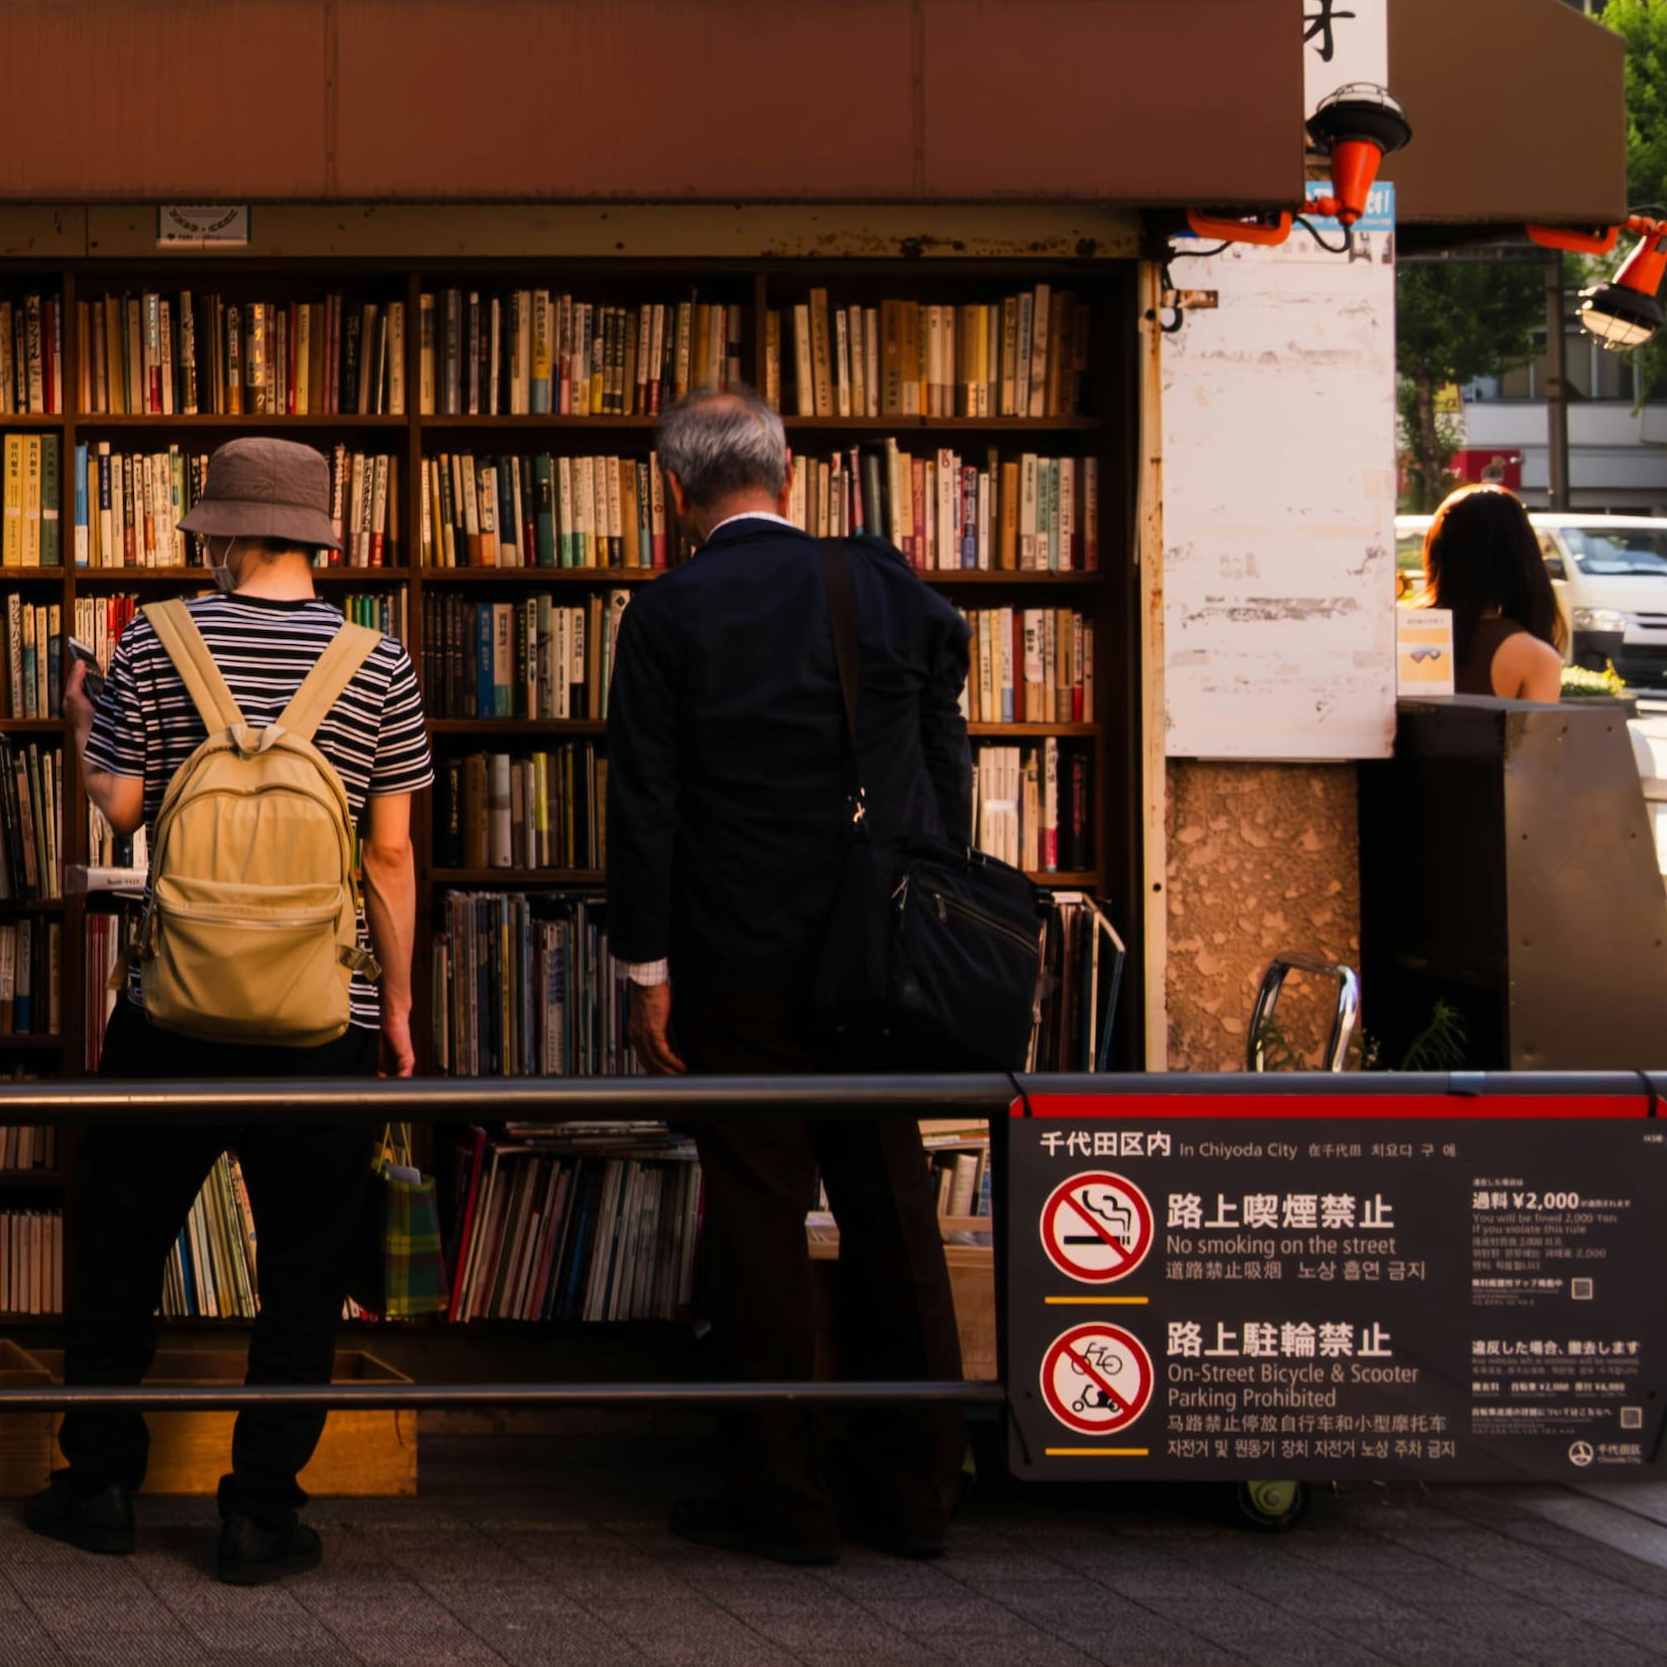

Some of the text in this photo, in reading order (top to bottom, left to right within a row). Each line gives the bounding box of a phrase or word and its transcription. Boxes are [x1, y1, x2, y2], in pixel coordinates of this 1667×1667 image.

[1040, 1130, 1171, 1158] 千代田区内
[1180, 1142, 1298, 1161] In Chiyoda City
[1166, 1193, 1394, 1229] 路上喫煙禁止
[1513, 1191, 1580, 1211] ¥2,000
[1166, 1234, 1396, 1260] No smoking on the street
[1166, 1260, 1282, 1280] 道路禁止吸烟
[1298, 1260, 1425, 1281] 노상 흡연 금지
[1166, 1321, 1392, 1358] 路上駐輪禁止
[1167, 1362, 1419, 1387] On-Street Bicycle & Scooter
[1168, 1386, 1337, 1412] Parking Prohibited
[1167, 1439, 1455, 1459] 자전거 및 원동기 장치 자전거 노상 주차 금지
